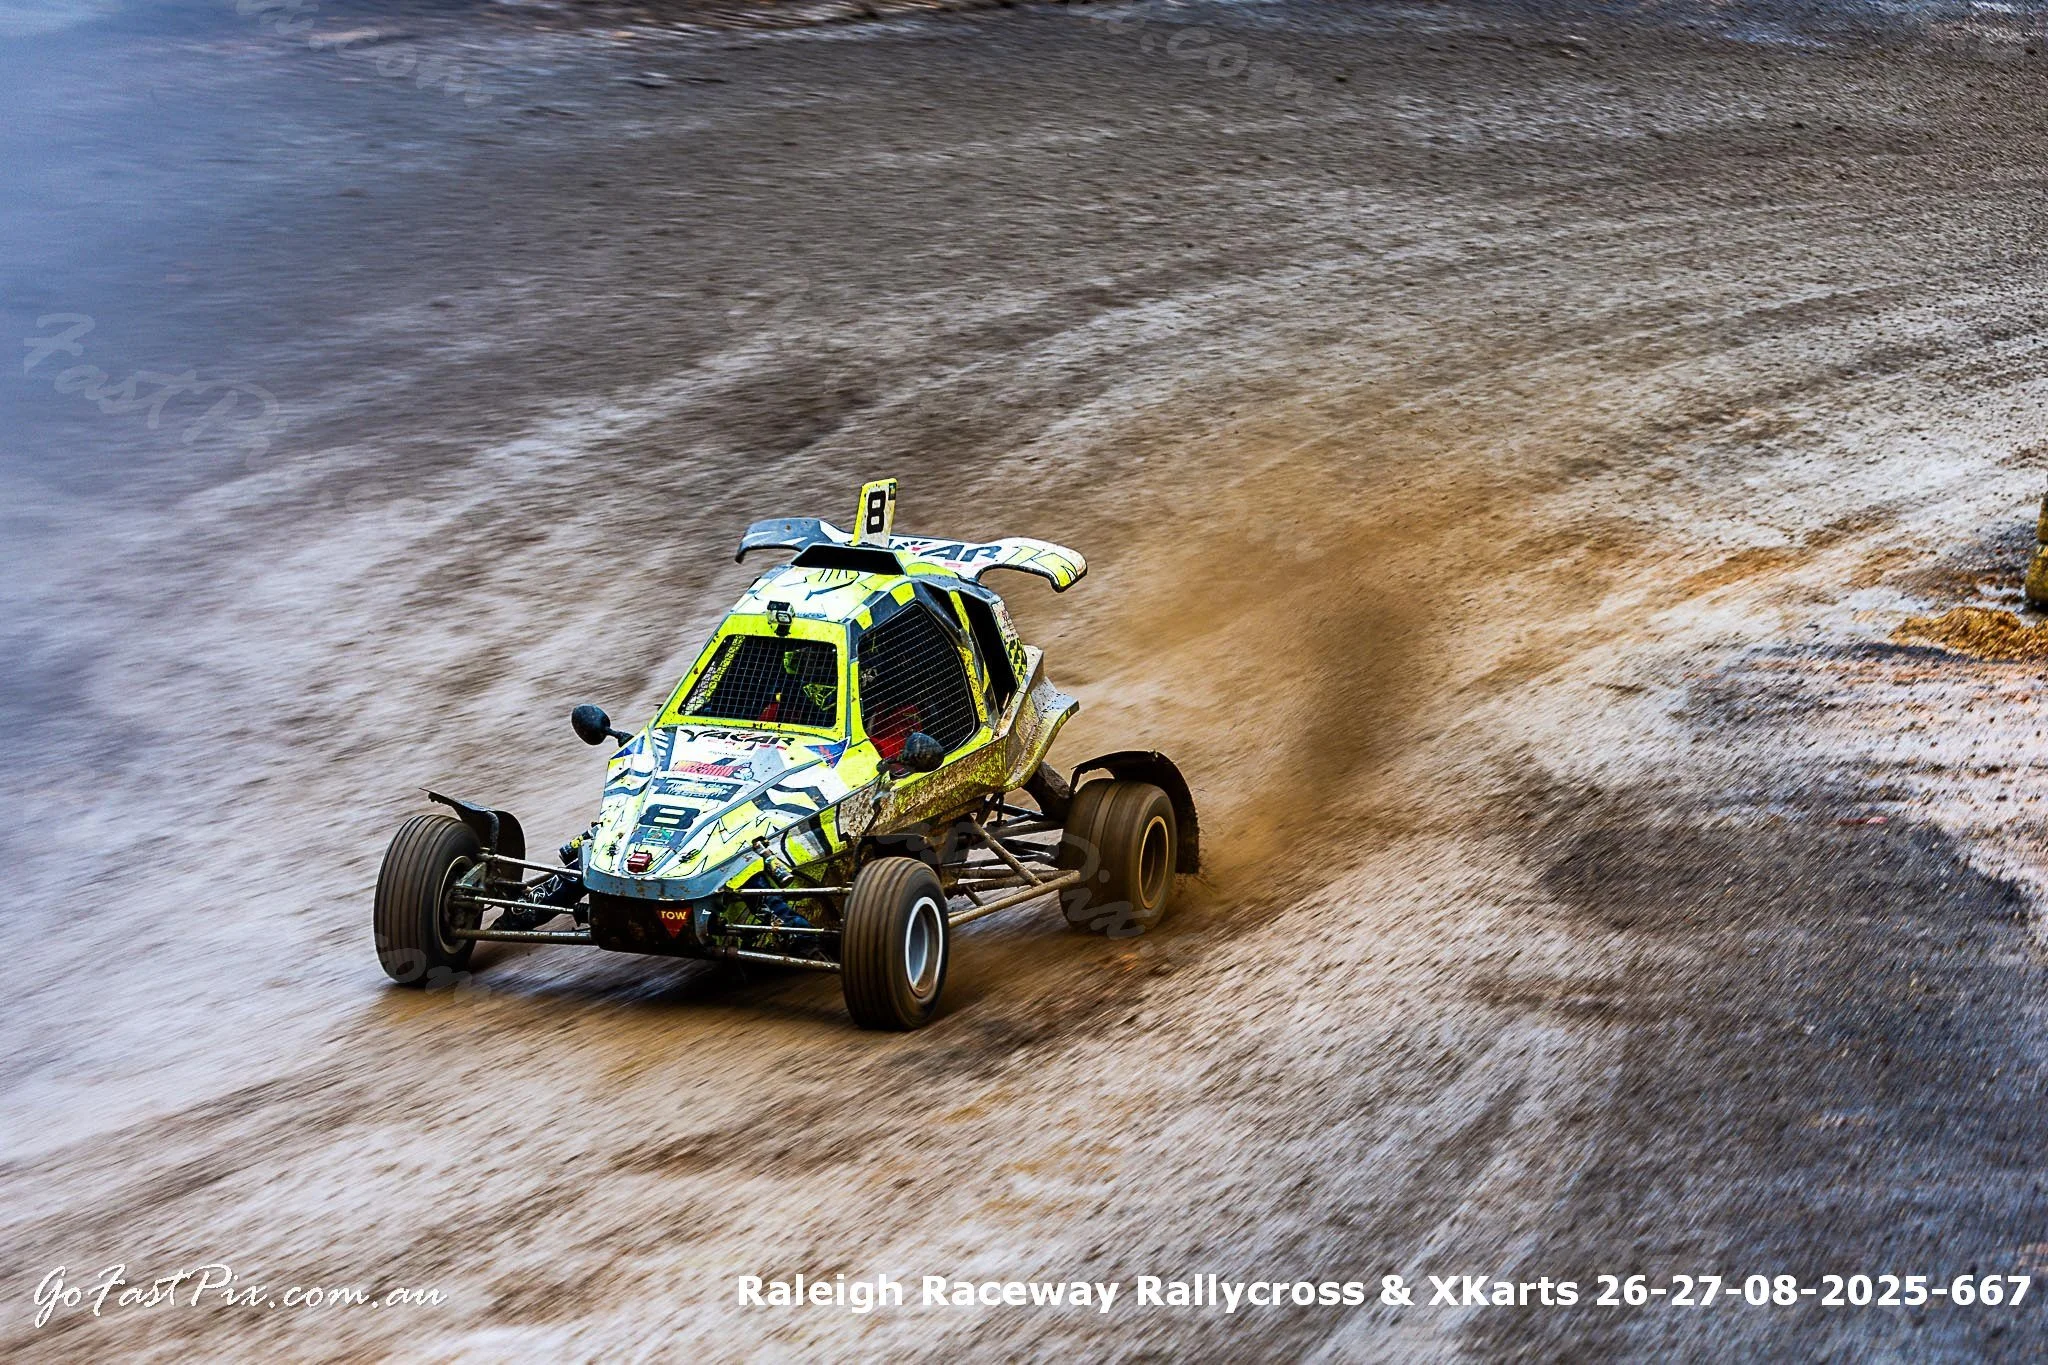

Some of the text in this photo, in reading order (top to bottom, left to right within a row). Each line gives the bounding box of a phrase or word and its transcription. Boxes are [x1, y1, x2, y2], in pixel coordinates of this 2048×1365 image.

[866, 490, 887, 535] 8
[680, 728, 796, 747] YACAR
[638, 803, 701, 830] 8
[660, 910, 687, 920] TOW
